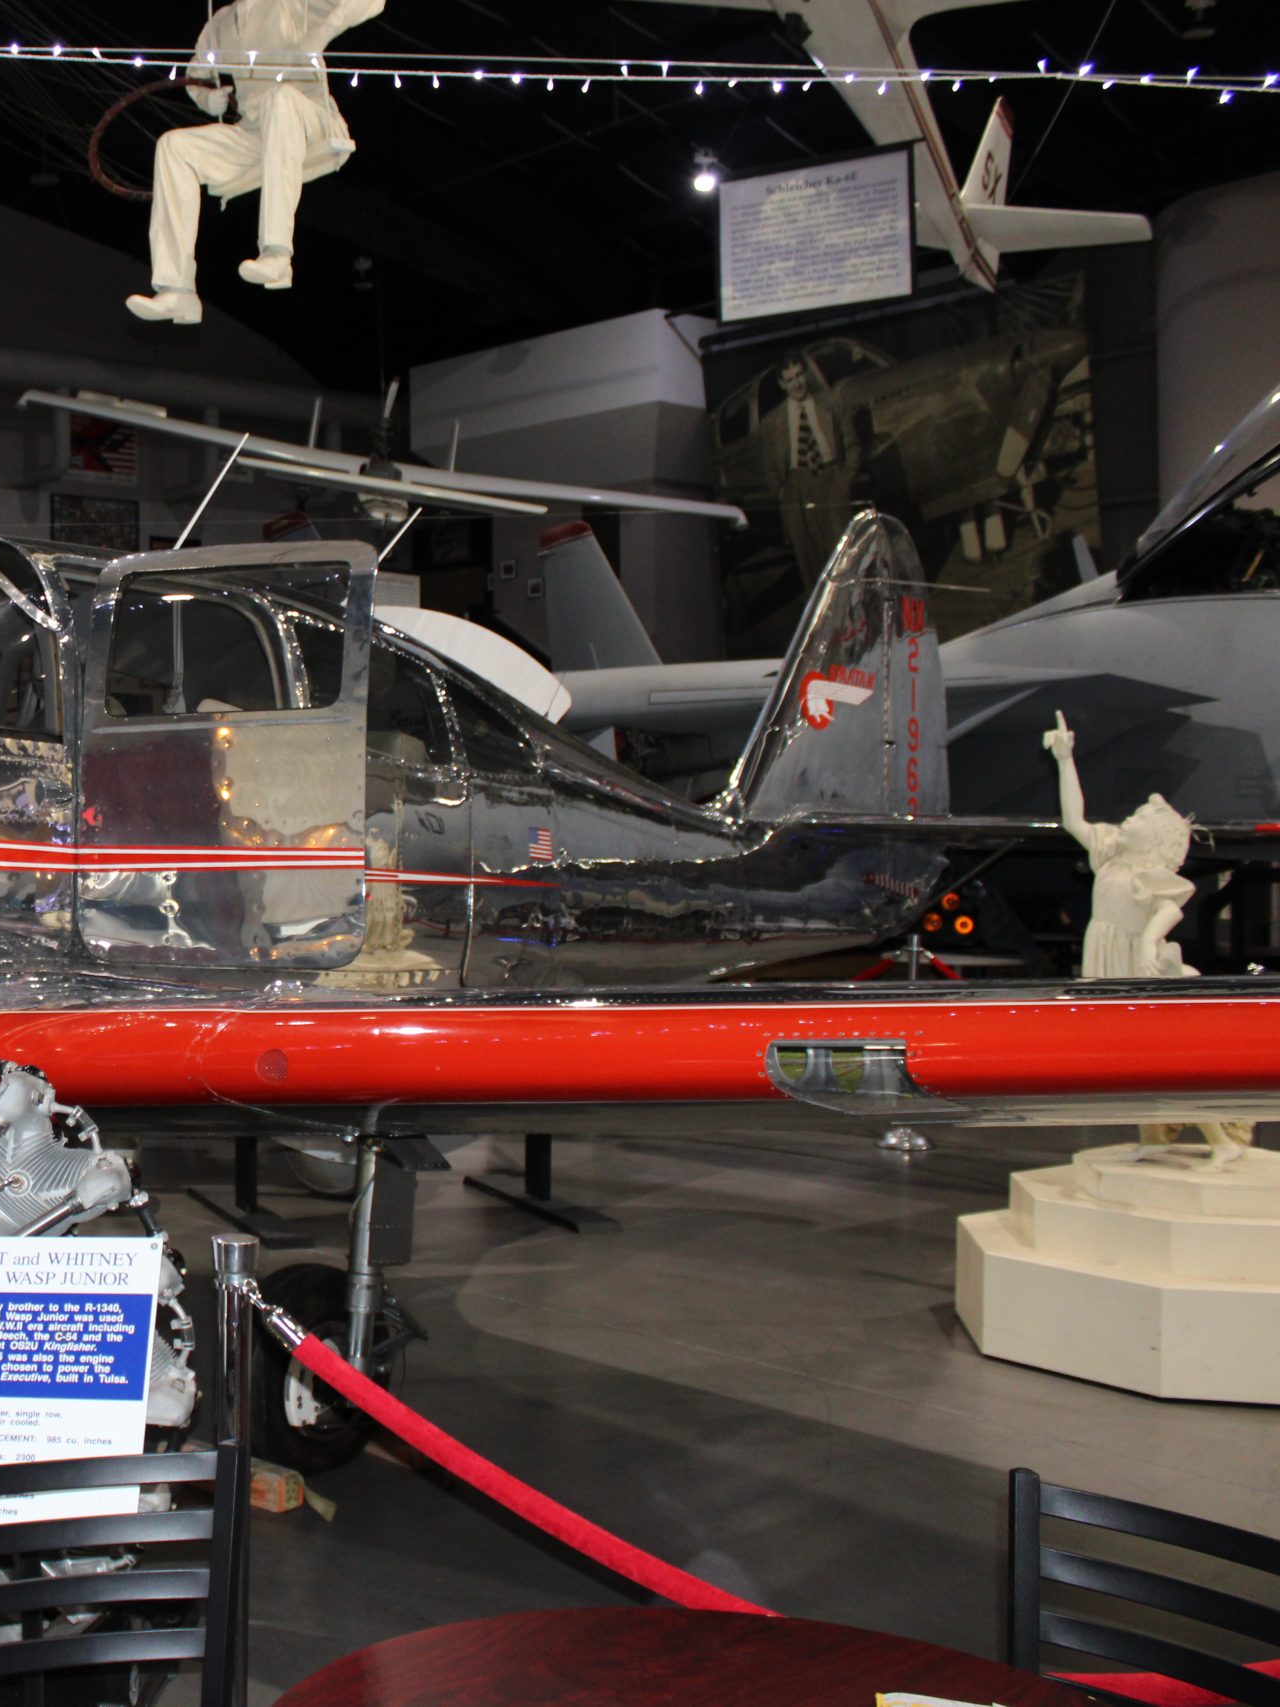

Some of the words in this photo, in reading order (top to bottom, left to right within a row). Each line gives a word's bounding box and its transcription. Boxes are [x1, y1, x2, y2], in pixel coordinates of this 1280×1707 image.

[828, 664, 876, 689] SPARTAN
[13, 1252, 40, 1265] and
[48, 1252, 138, 1266] WHITNEY
[6, 1271, 55, 1285] WASP
[60, 1272, 129, 1286] JUNIOR
[8, 1302, 44, 1312] brother
[48, 1303, 59, 1311] to
[64, 1303, 80, 1312] the
[85, 1303, 121, 1313] R-1340,
[6, 1311, 32, 1322] Wasp
[37, 1312, 69, 1322] Junior
[74, 1314, 93, 1322] was
[99, 1313, 124, 1322] used
[27, 1323, 43, 1331] era
[48, 1322, 83, 1331] aircraft
[88, 1323, 135, 1334] including
[34, 1332, 50, 1341] the
[55, 1332, 77, 1341] C-54
[82, 1333, 102, 1342] and
[106, 1333, 123, 1342] the
[43, 1341, 97, 1352] Kingfisher.
[8, 1354, 28, 1362] was
[33, 1353, 54, 1362] also
[59, 1354, 75, 1363] the
[80, 1354, 114, 1365] engine
[1, 1362, 37, 1372] chosen
[43, 1363, 53, 1372] to
[58, 1365, 89, 1375] power
[94, 1365, 111, 1373] the
[0, 1372, 51, 1383] Executive,
[56, 1373, 79, 1383] built
[83, 1374, 93, 1383] in
[99, 1374, 129, 1384] Tulsa.
[15, 1410, 40, 1418] single
[45, 1411, 63, 1419] row,
[46, 1436, 61, 1444] 985
[83, 1436, 112, 1445] inches
